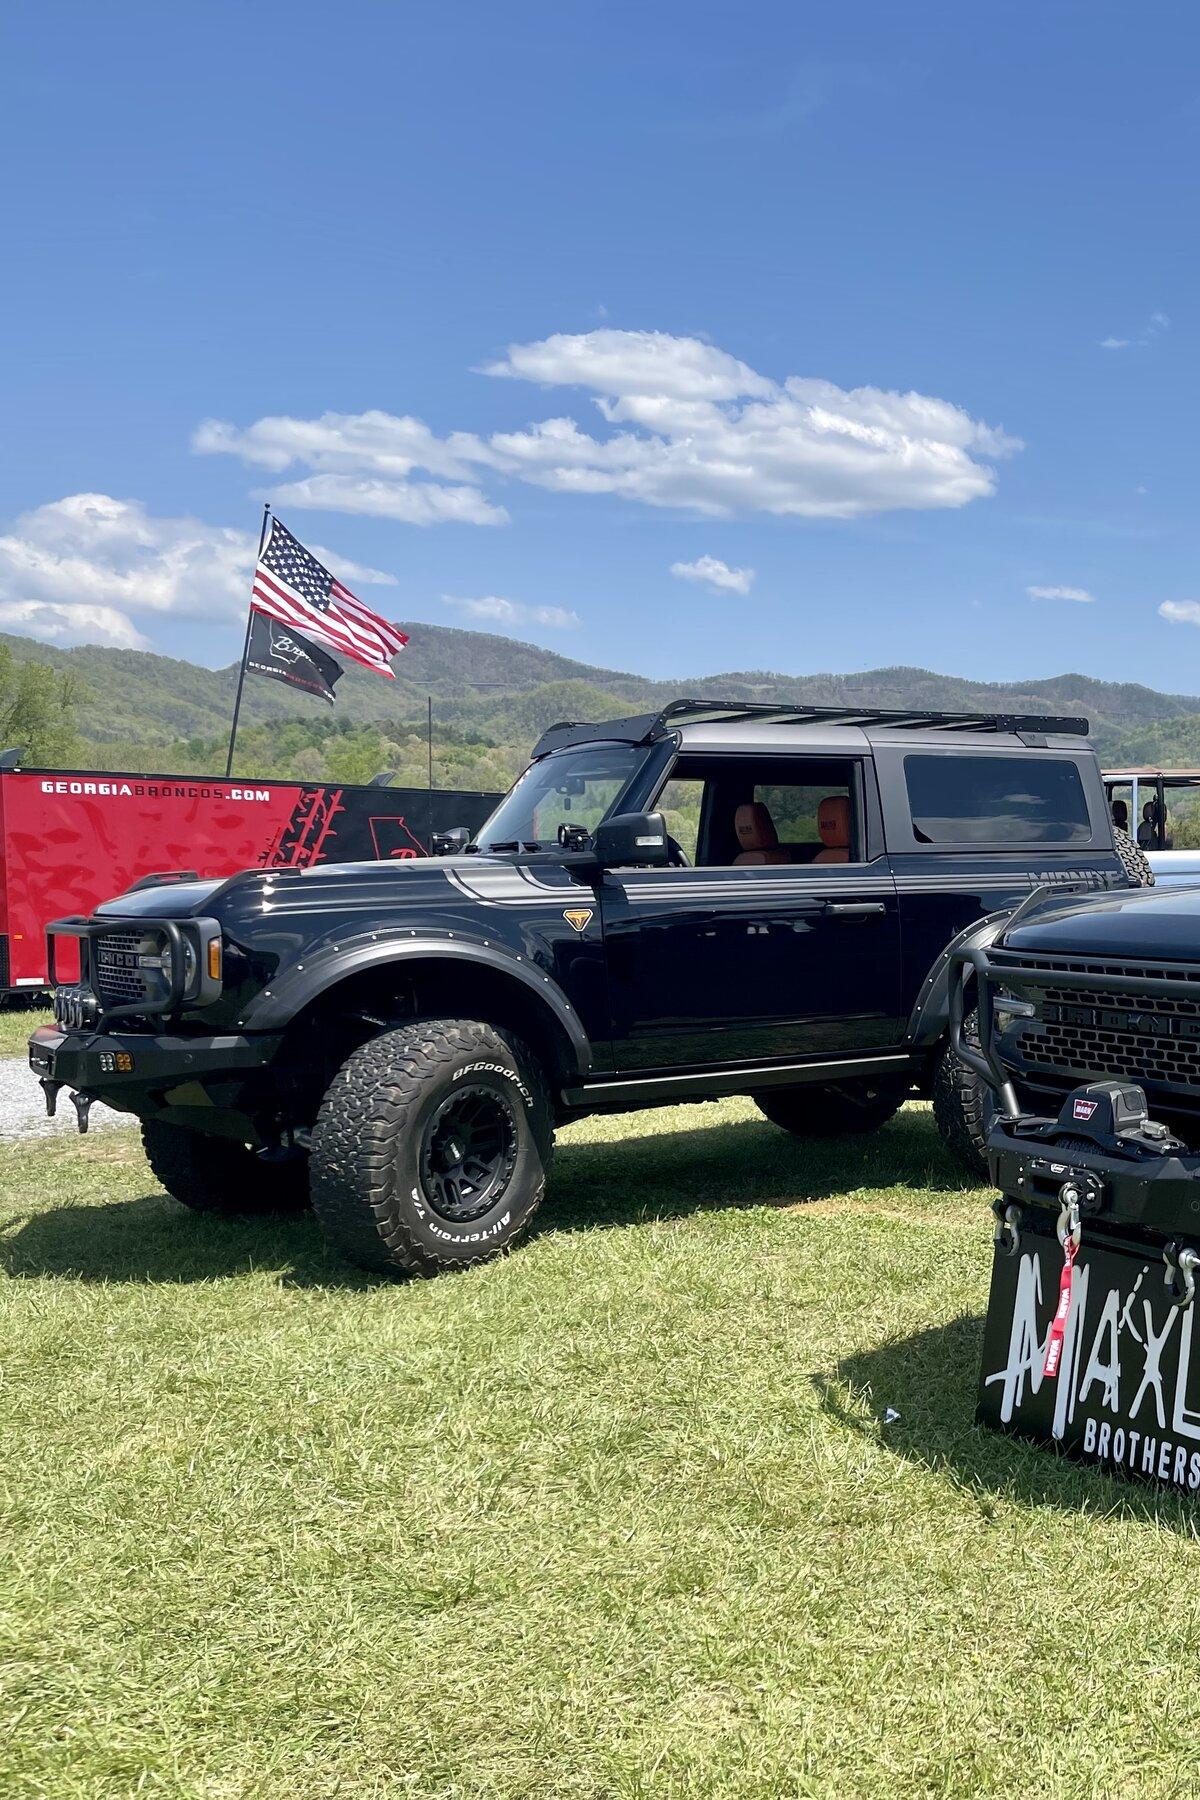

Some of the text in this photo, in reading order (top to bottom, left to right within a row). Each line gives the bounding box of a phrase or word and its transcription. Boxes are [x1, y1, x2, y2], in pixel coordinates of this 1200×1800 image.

[41, 781, 270, 802] GEORGIABRONCOS.COM
[452, 1061, 535, 1108] BFGoodrich
[411, 1187, 511, 1243] All-Terrain T/A
[1058, 1287, 1070, 1319] WARN
[1046, 1338, 1061, 1373] WARN
